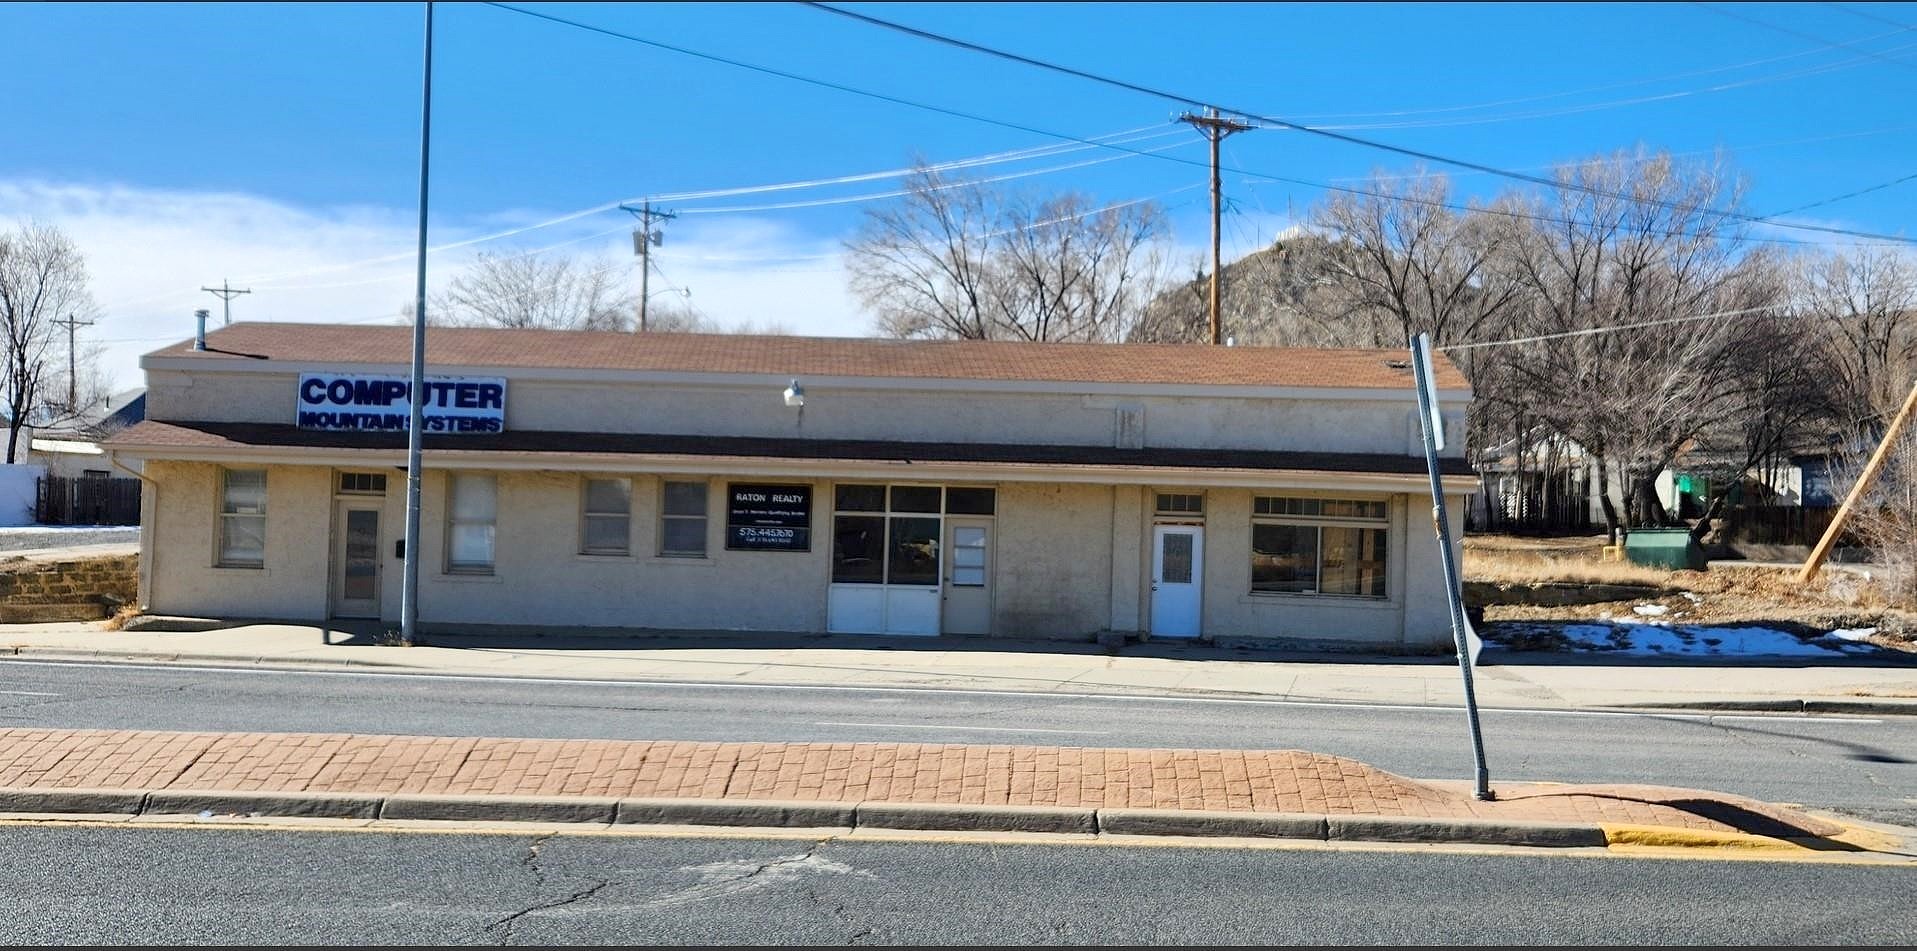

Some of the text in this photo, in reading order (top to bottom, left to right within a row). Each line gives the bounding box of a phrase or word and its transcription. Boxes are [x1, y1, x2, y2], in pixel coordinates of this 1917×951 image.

[301, 378, 503, 409] COMPUTER
[299, 411, 404, 431] MOUNTAIN
[736, 493, 803, 503] RATON REALTY
